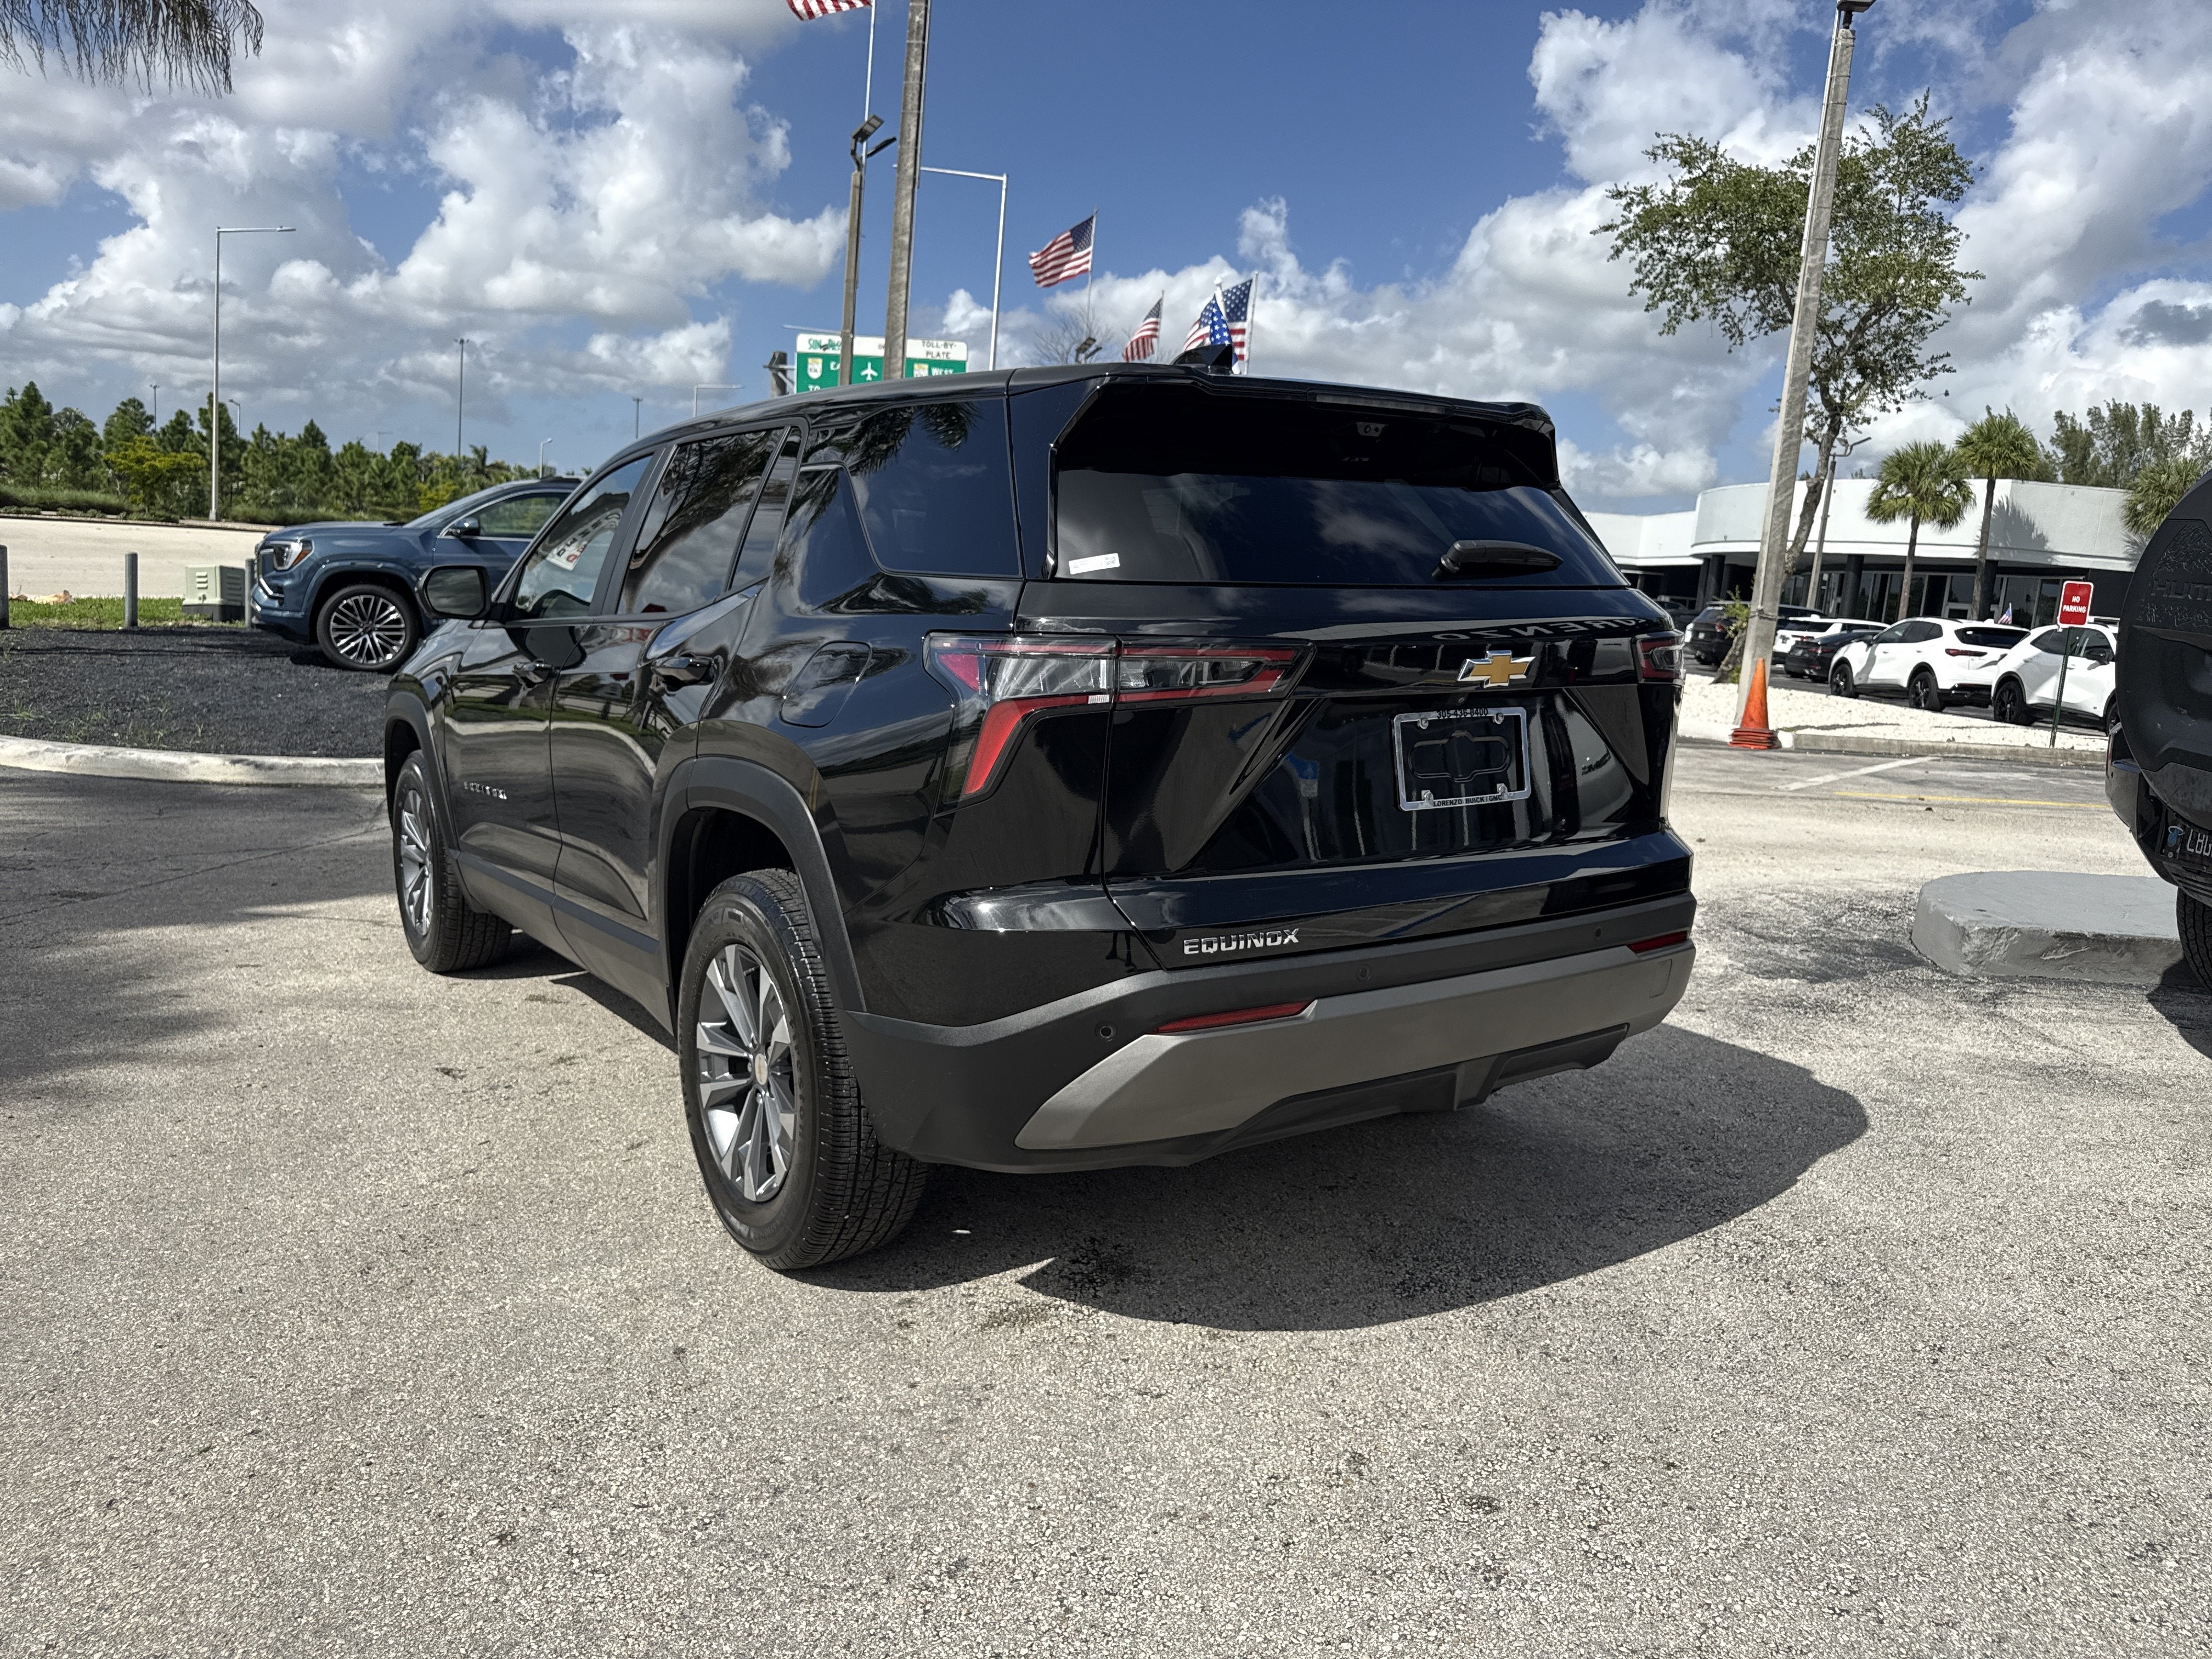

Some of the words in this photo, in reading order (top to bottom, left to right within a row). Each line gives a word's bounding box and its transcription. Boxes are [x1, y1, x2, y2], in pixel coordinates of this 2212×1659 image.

[926, 351, 951, 359] PLATE
[2063, 604, 2086, 613] PARKING
[1436, 707, 1488, 719] 305-436-8400
[1433, 799, 1463, 807] LORENZO
[1465, 795, 1485, 804] BUICK
[1183, 928, 1299, 955] EQUINOX
